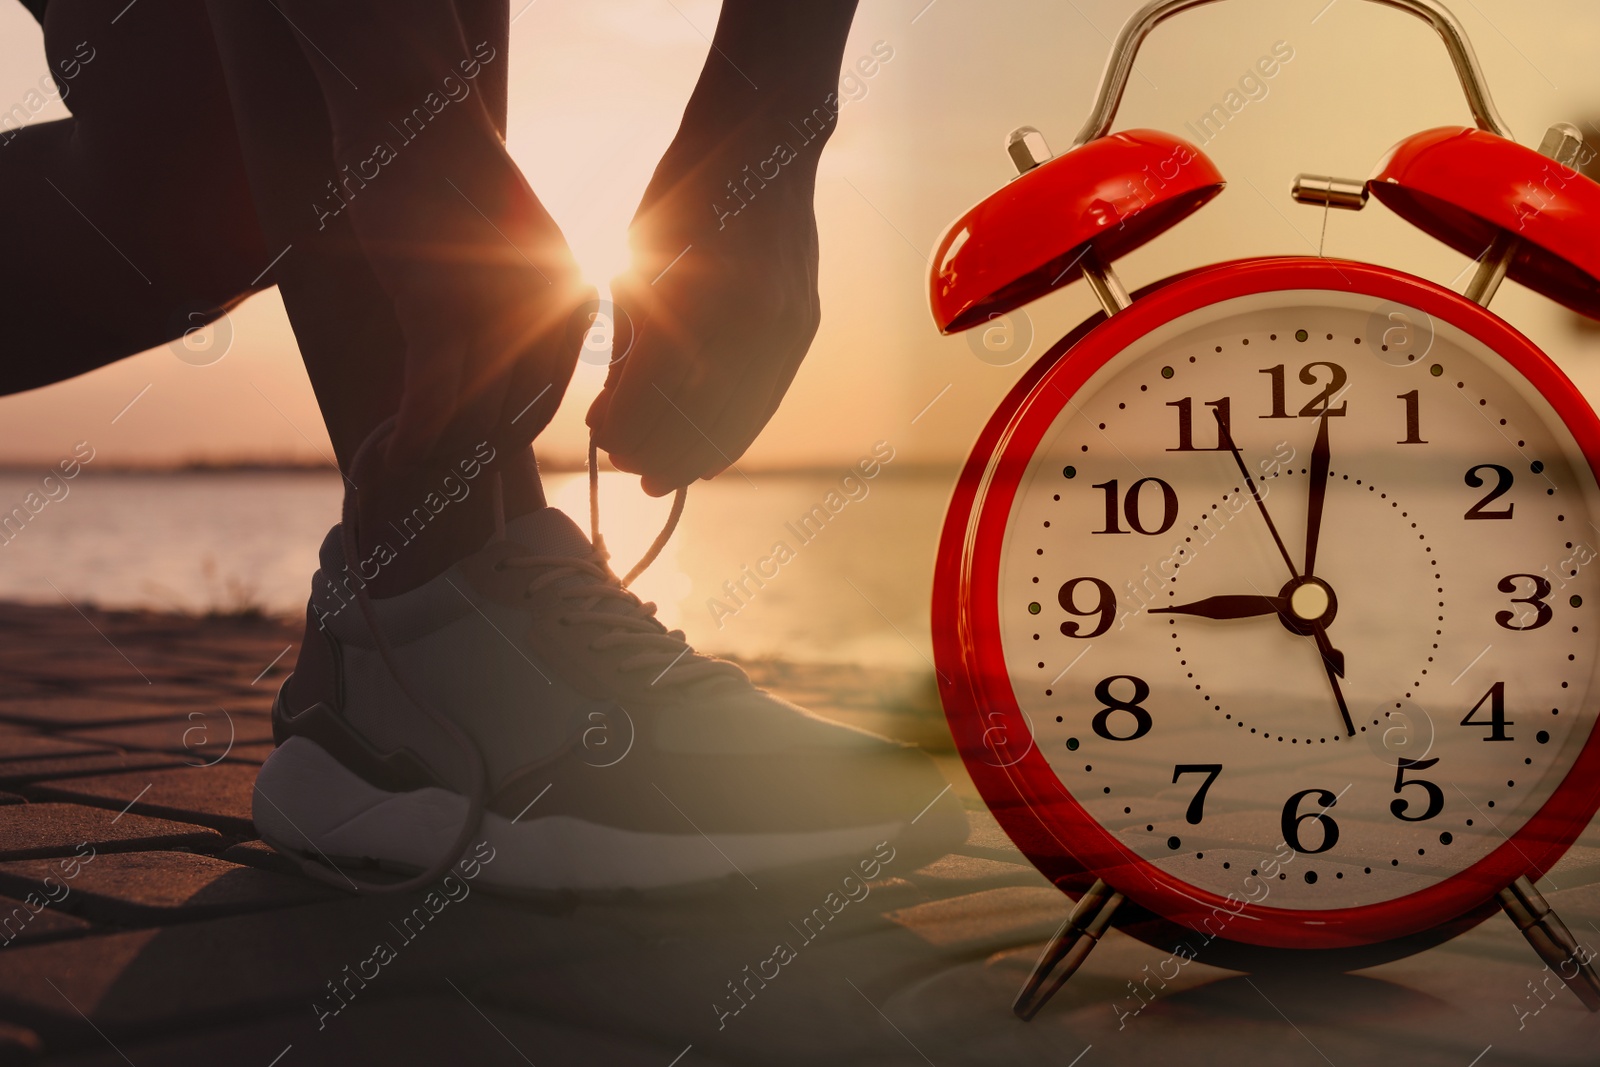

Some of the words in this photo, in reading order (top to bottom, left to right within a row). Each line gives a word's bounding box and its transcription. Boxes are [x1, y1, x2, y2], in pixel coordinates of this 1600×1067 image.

[1258, 361, 1349, 419] 12
[1396, 390, 1428, 444] 1
[1166, 397, 1242, 452] 11
[1091, 478, 1179, 535] 10
[1464, 464, 1515, 520] 2
[1058, 576, 1117, 638] 9
[1495, 573, 1554, 631] 3
[1091, 675, 1153, 741] 8
[1460, 682, 1514, 742] 4
[1172, 764, 1223, 825] 7
[1389, 757, 1444, 822] 5
[1280, 788, 1339, 854] 6
